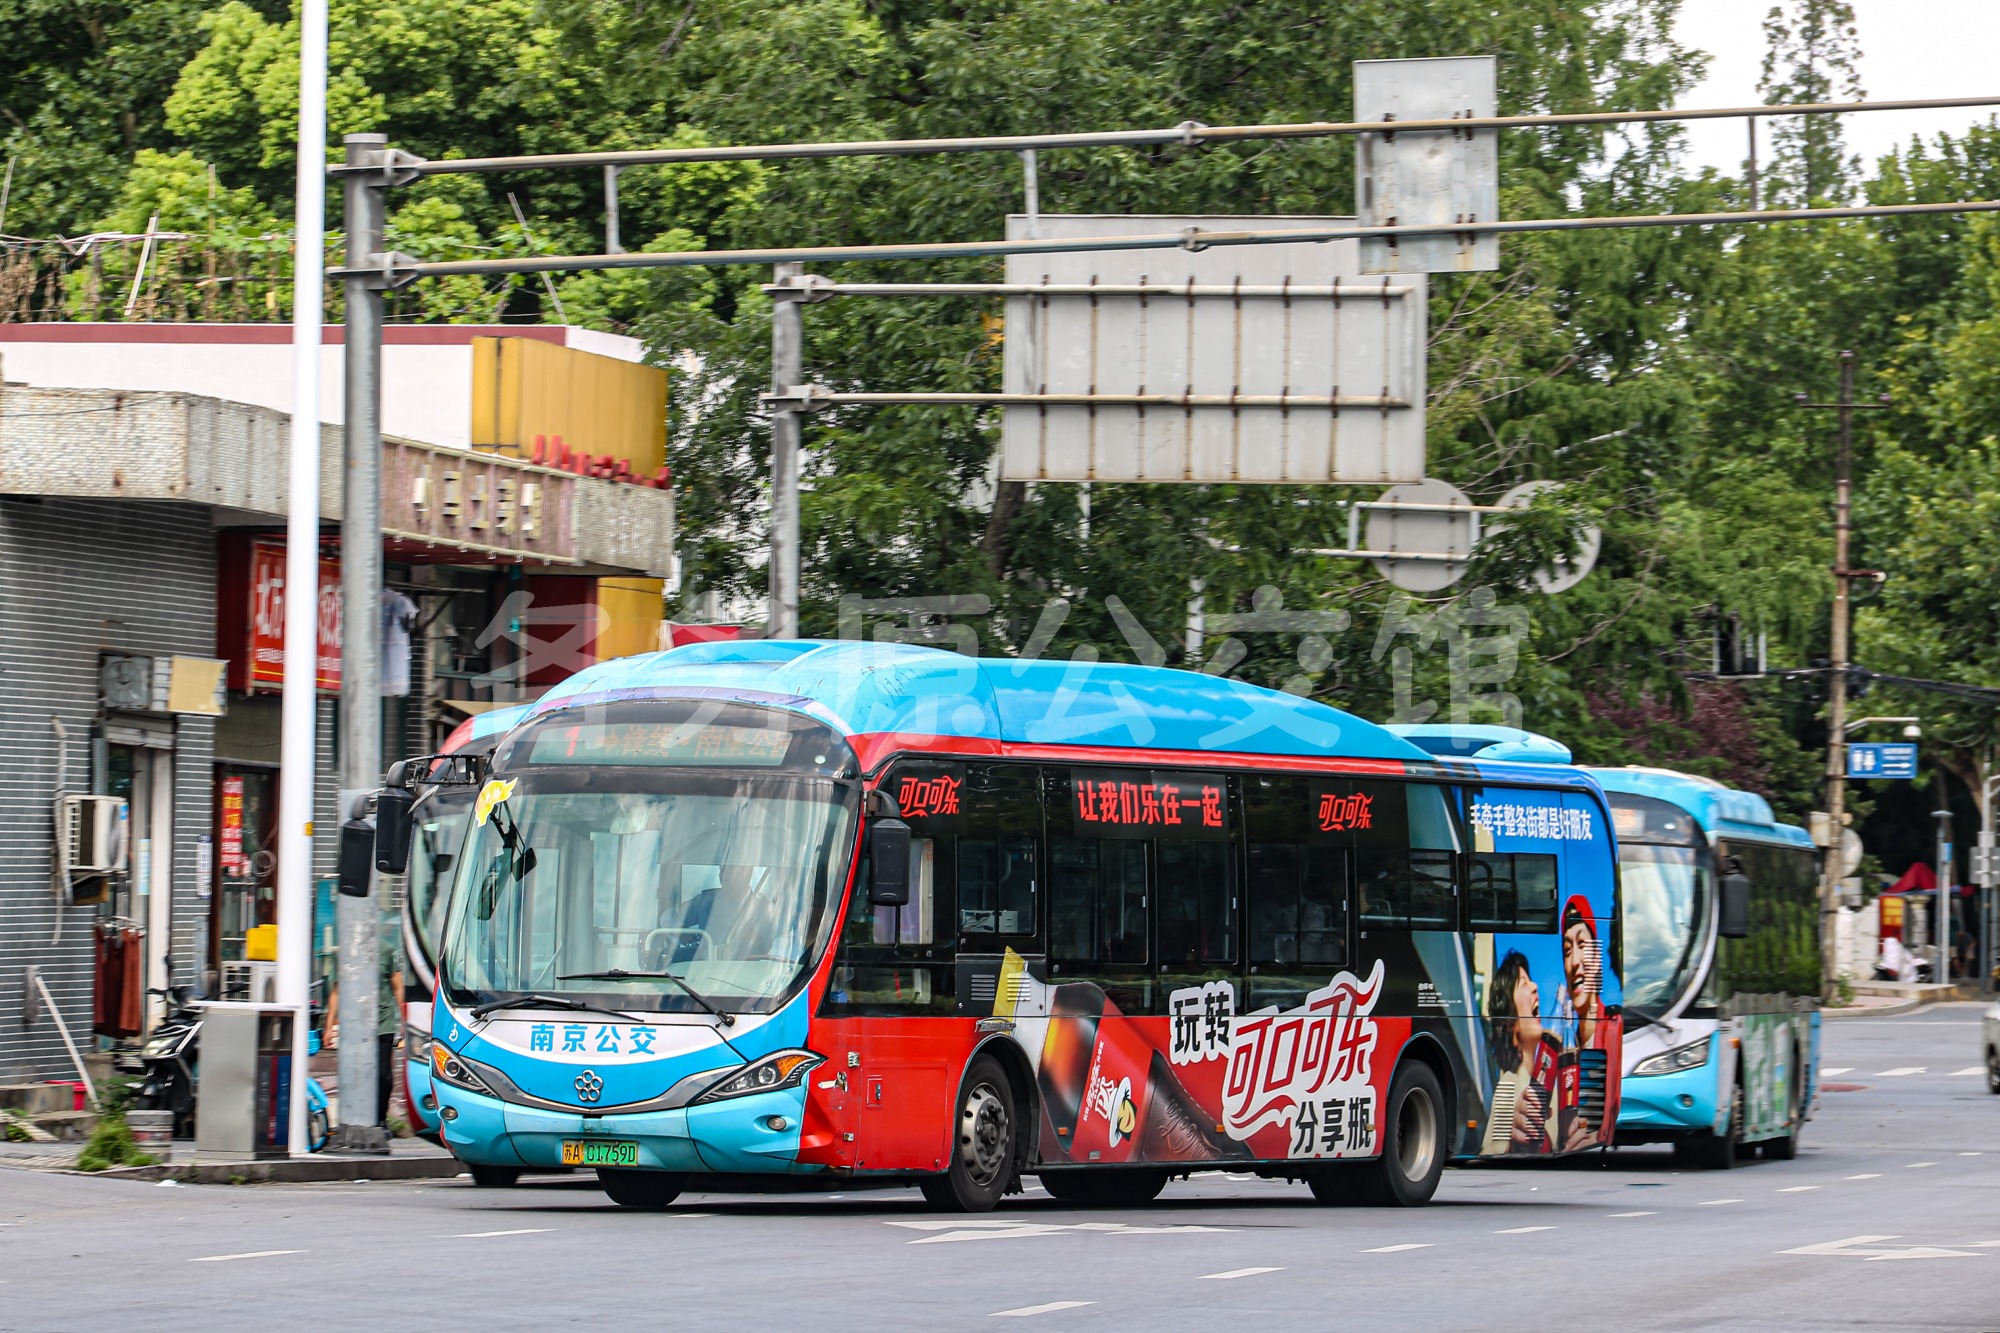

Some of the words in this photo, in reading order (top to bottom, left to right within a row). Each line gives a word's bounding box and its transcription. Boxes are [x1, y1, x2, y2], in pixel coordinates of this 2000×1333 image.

[899, 775, 962, 818] 可口可乐
[1078, 780, 1223, 827] 让我们乐在一起
[1319, 792, 1373, 832] 可口可乐
[1469, 803, 1593, 840] 手牵手整条街都是好朋友
[530, 1023, 657, 1055] 南京公交
[1174, 991, 1230, 1055] 玩转
[1227, 972, 1380, 1129] 可口可乐
[1293, 1096, 1373, 1155] 分享瓶
